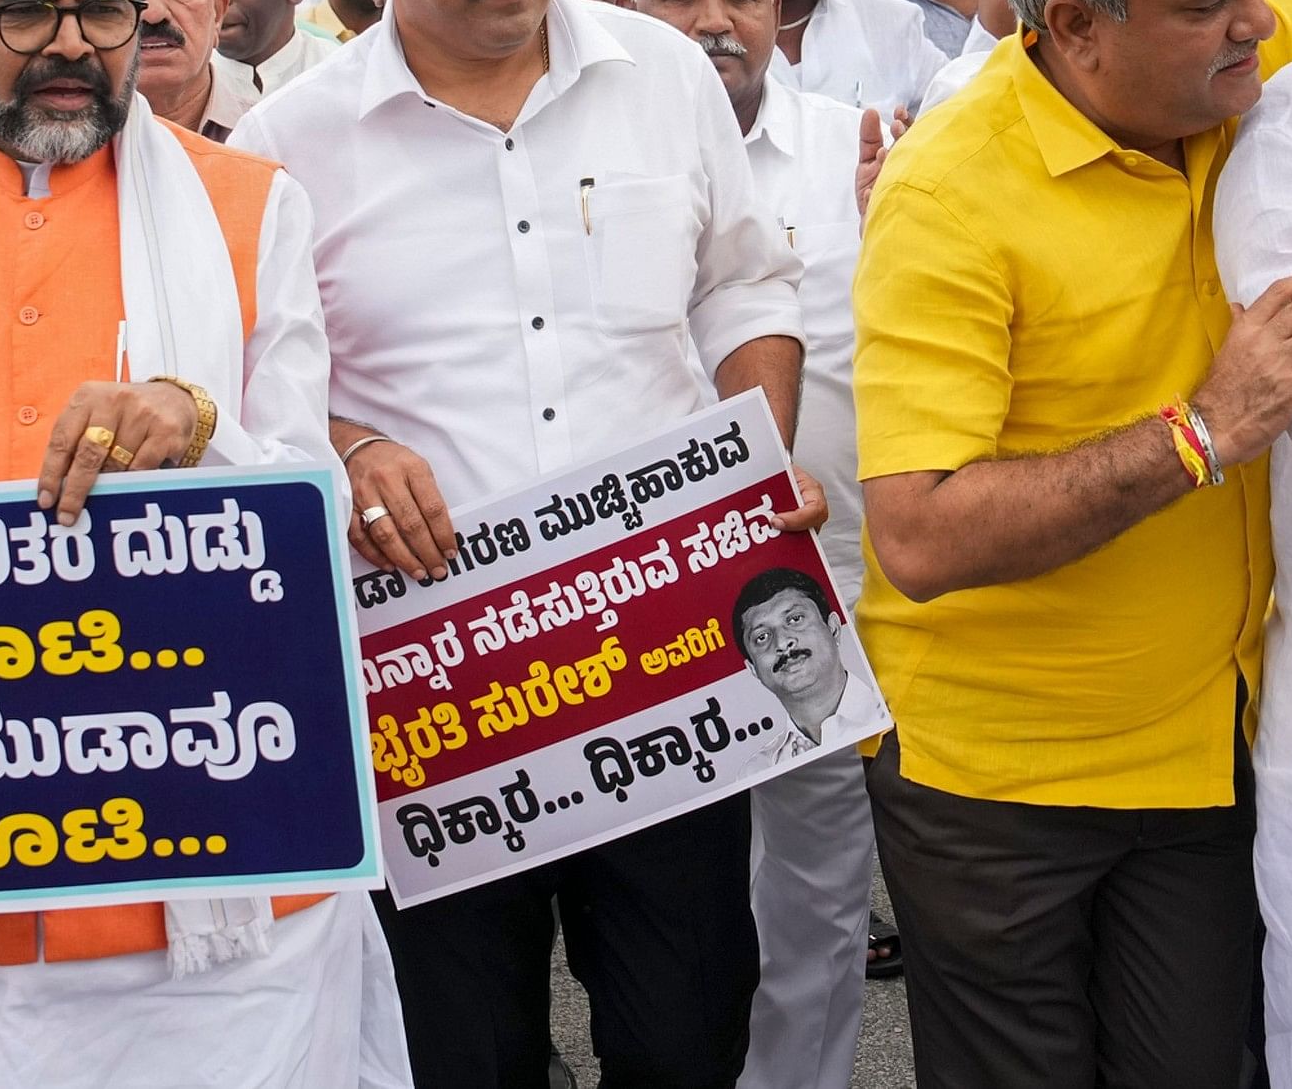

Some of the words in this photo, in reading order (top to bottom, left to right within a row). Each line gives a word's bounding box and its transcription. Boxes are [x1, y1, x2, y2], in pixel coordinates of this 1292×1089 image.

[110, 497, 284, 603] ದುಡ್ಡು
[353, 567, 407, 609] ಡಾ
[417, 518, 531, 587] ಗರಣ
[534, 421, 751, 542] ಮುಚ್ಚಿಹಾಕುವ
[467, 539, 680, 657] ನಡೆಸುತ್ತಿರುವ
[681, 493, 781, 574] ಸಚಿವ
[469, 636, 628, 739] ಸುರೇಶ್
[640, 618, 727, 675] ಅವರಿಗೆ
[395, 769, 585, 868] ಧಿಕ್ಕಾರ...
[583, 697, 775, 803] ಧಿಕ್ಕಾರ...
